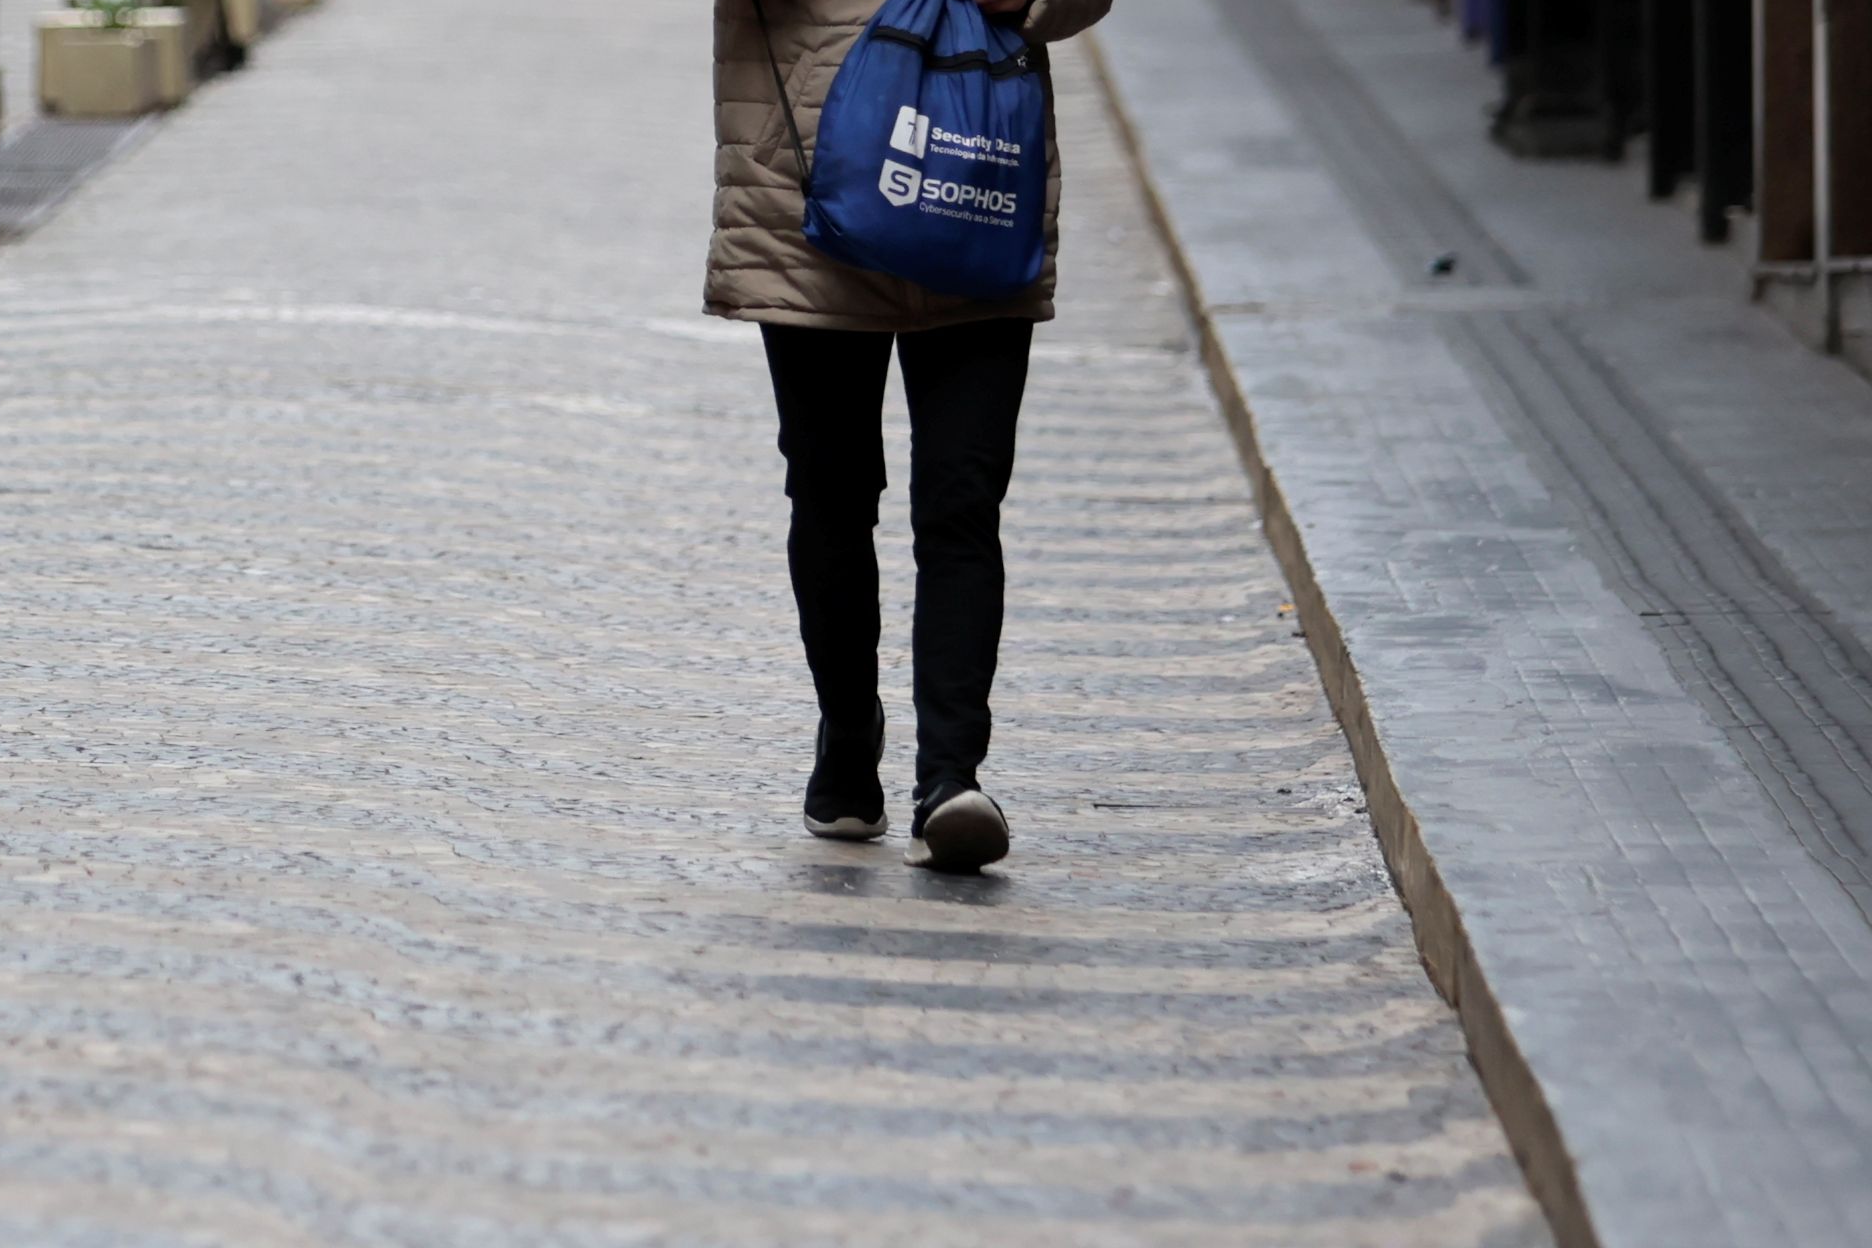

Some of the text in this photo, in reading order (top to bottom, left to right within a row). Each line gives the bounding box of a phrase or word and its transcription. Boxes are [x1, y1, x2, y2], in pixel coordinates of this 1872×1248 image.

[931, 127, 991, 152] Security
[930, 143, 976, 160] Tecnologia
[921, 178, 1017, 214] SOPHOS
[919, 201, 974, 222] Cybersecurity
